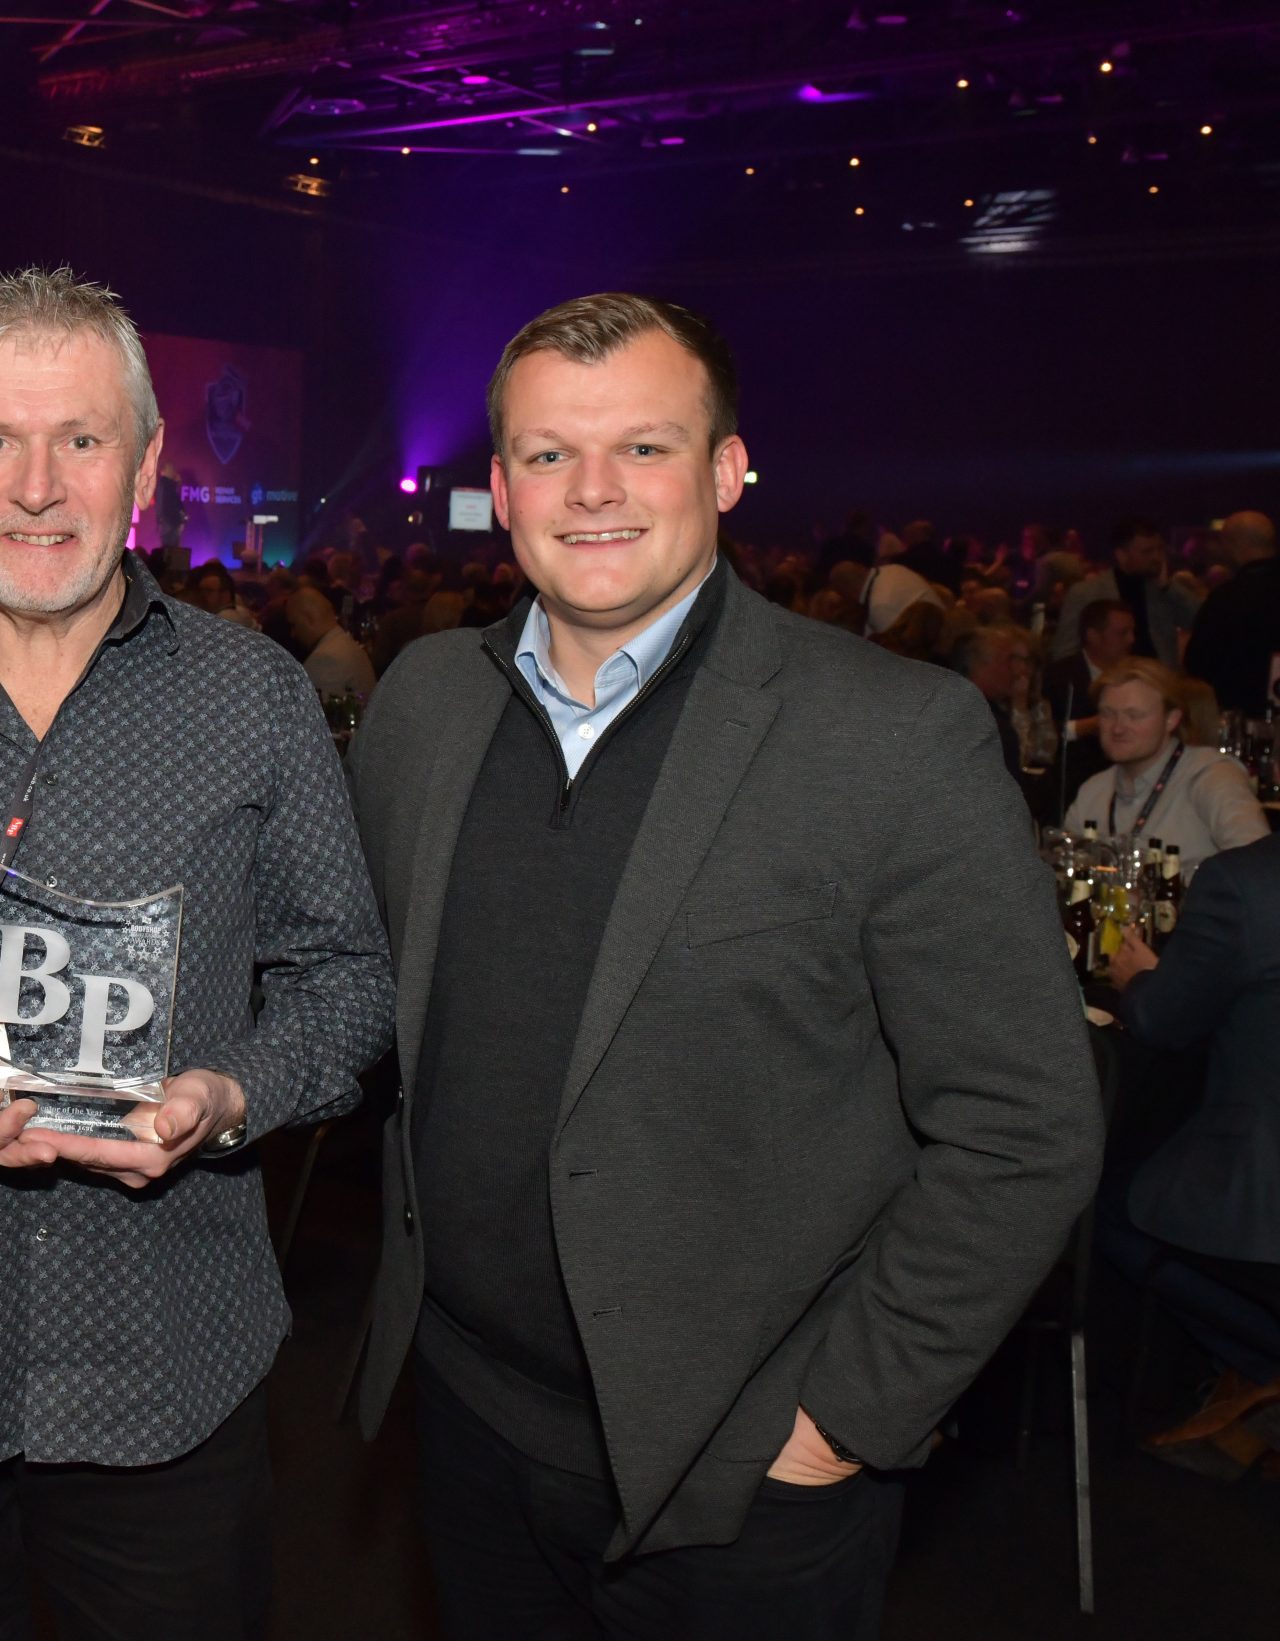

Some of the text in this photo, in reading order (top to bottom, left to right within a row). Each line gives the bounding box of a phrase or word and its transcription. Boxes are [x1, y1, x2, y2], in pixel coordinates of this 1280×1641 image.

[180, 486, 210, 503] FMG
[38, 1104, 103, 1117] entor of the Year
